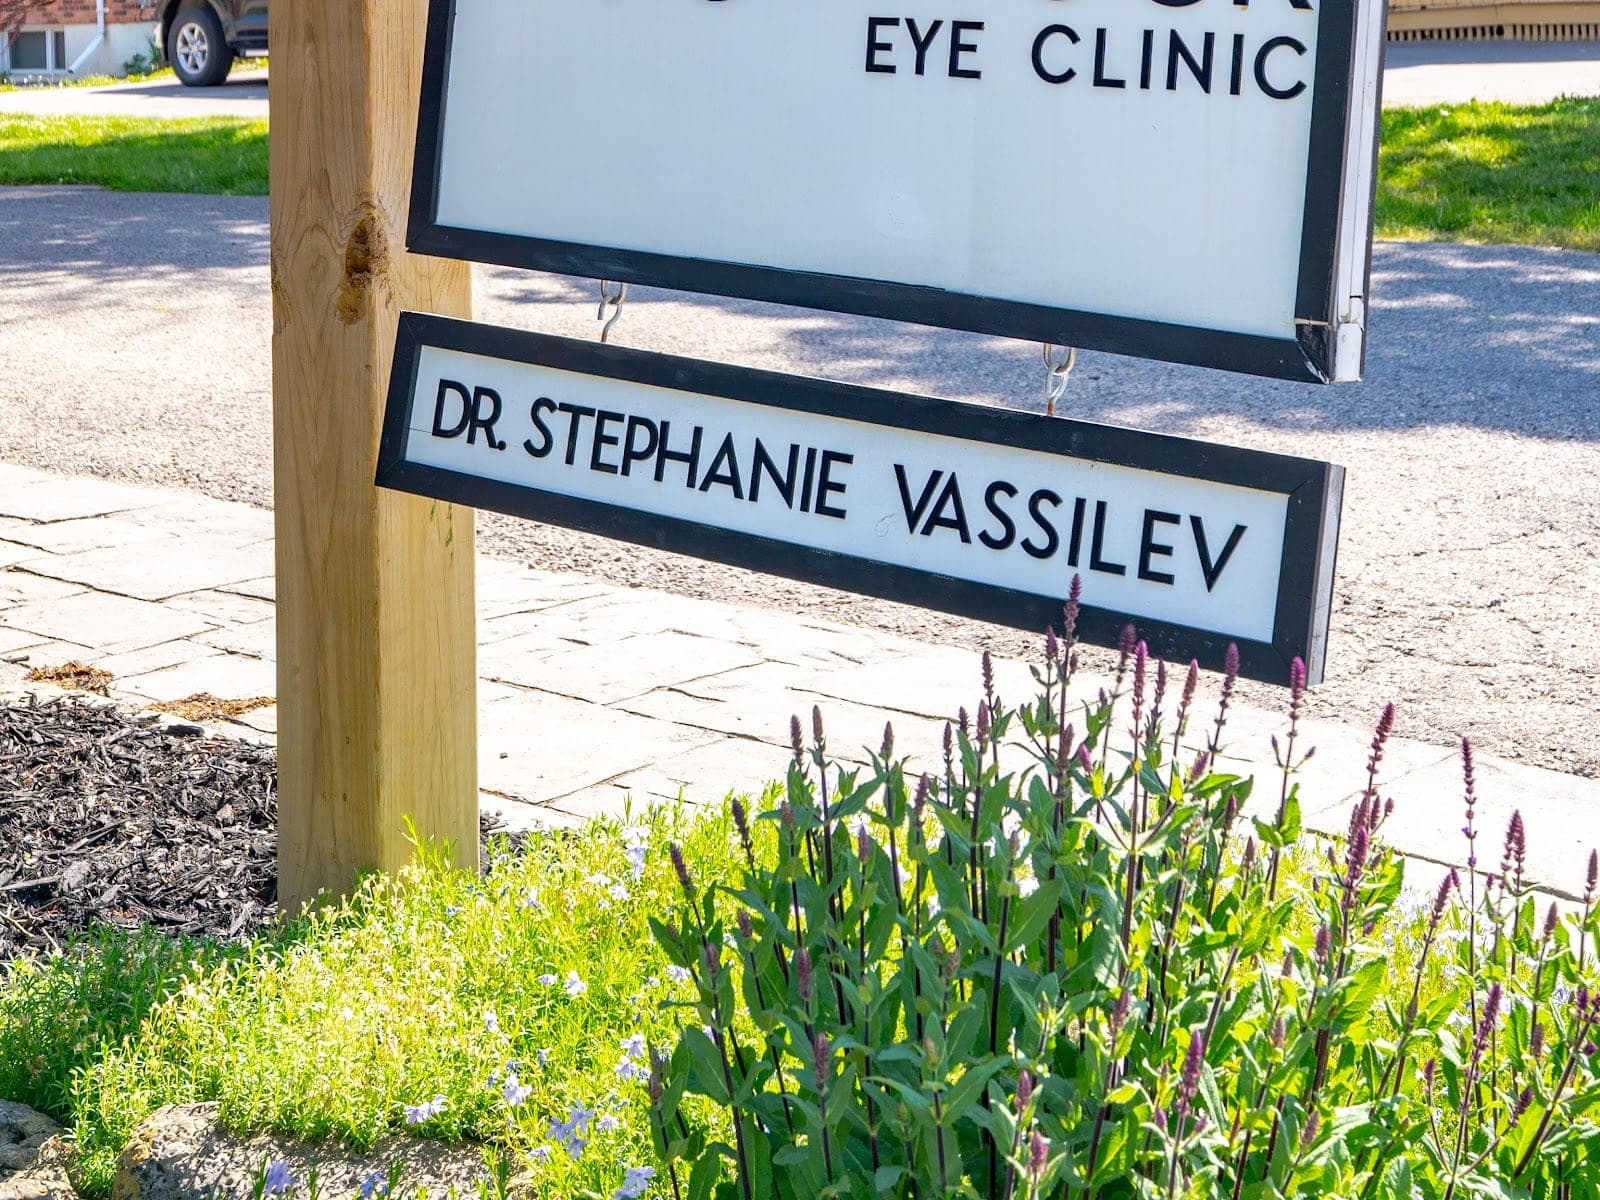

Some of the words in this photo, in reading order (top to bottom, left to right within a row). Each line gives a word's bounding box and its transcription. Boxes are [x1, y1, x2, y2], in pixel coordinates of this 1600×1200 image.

[865, 16, 985, 80] EYE
[1031, 23, 1308, 100] CLINIC
[431, 378, 506, 452] DR.
[522, 395, 855, 520] STEPHANIE
[893, 463, 1249, 593] VASSILEV
